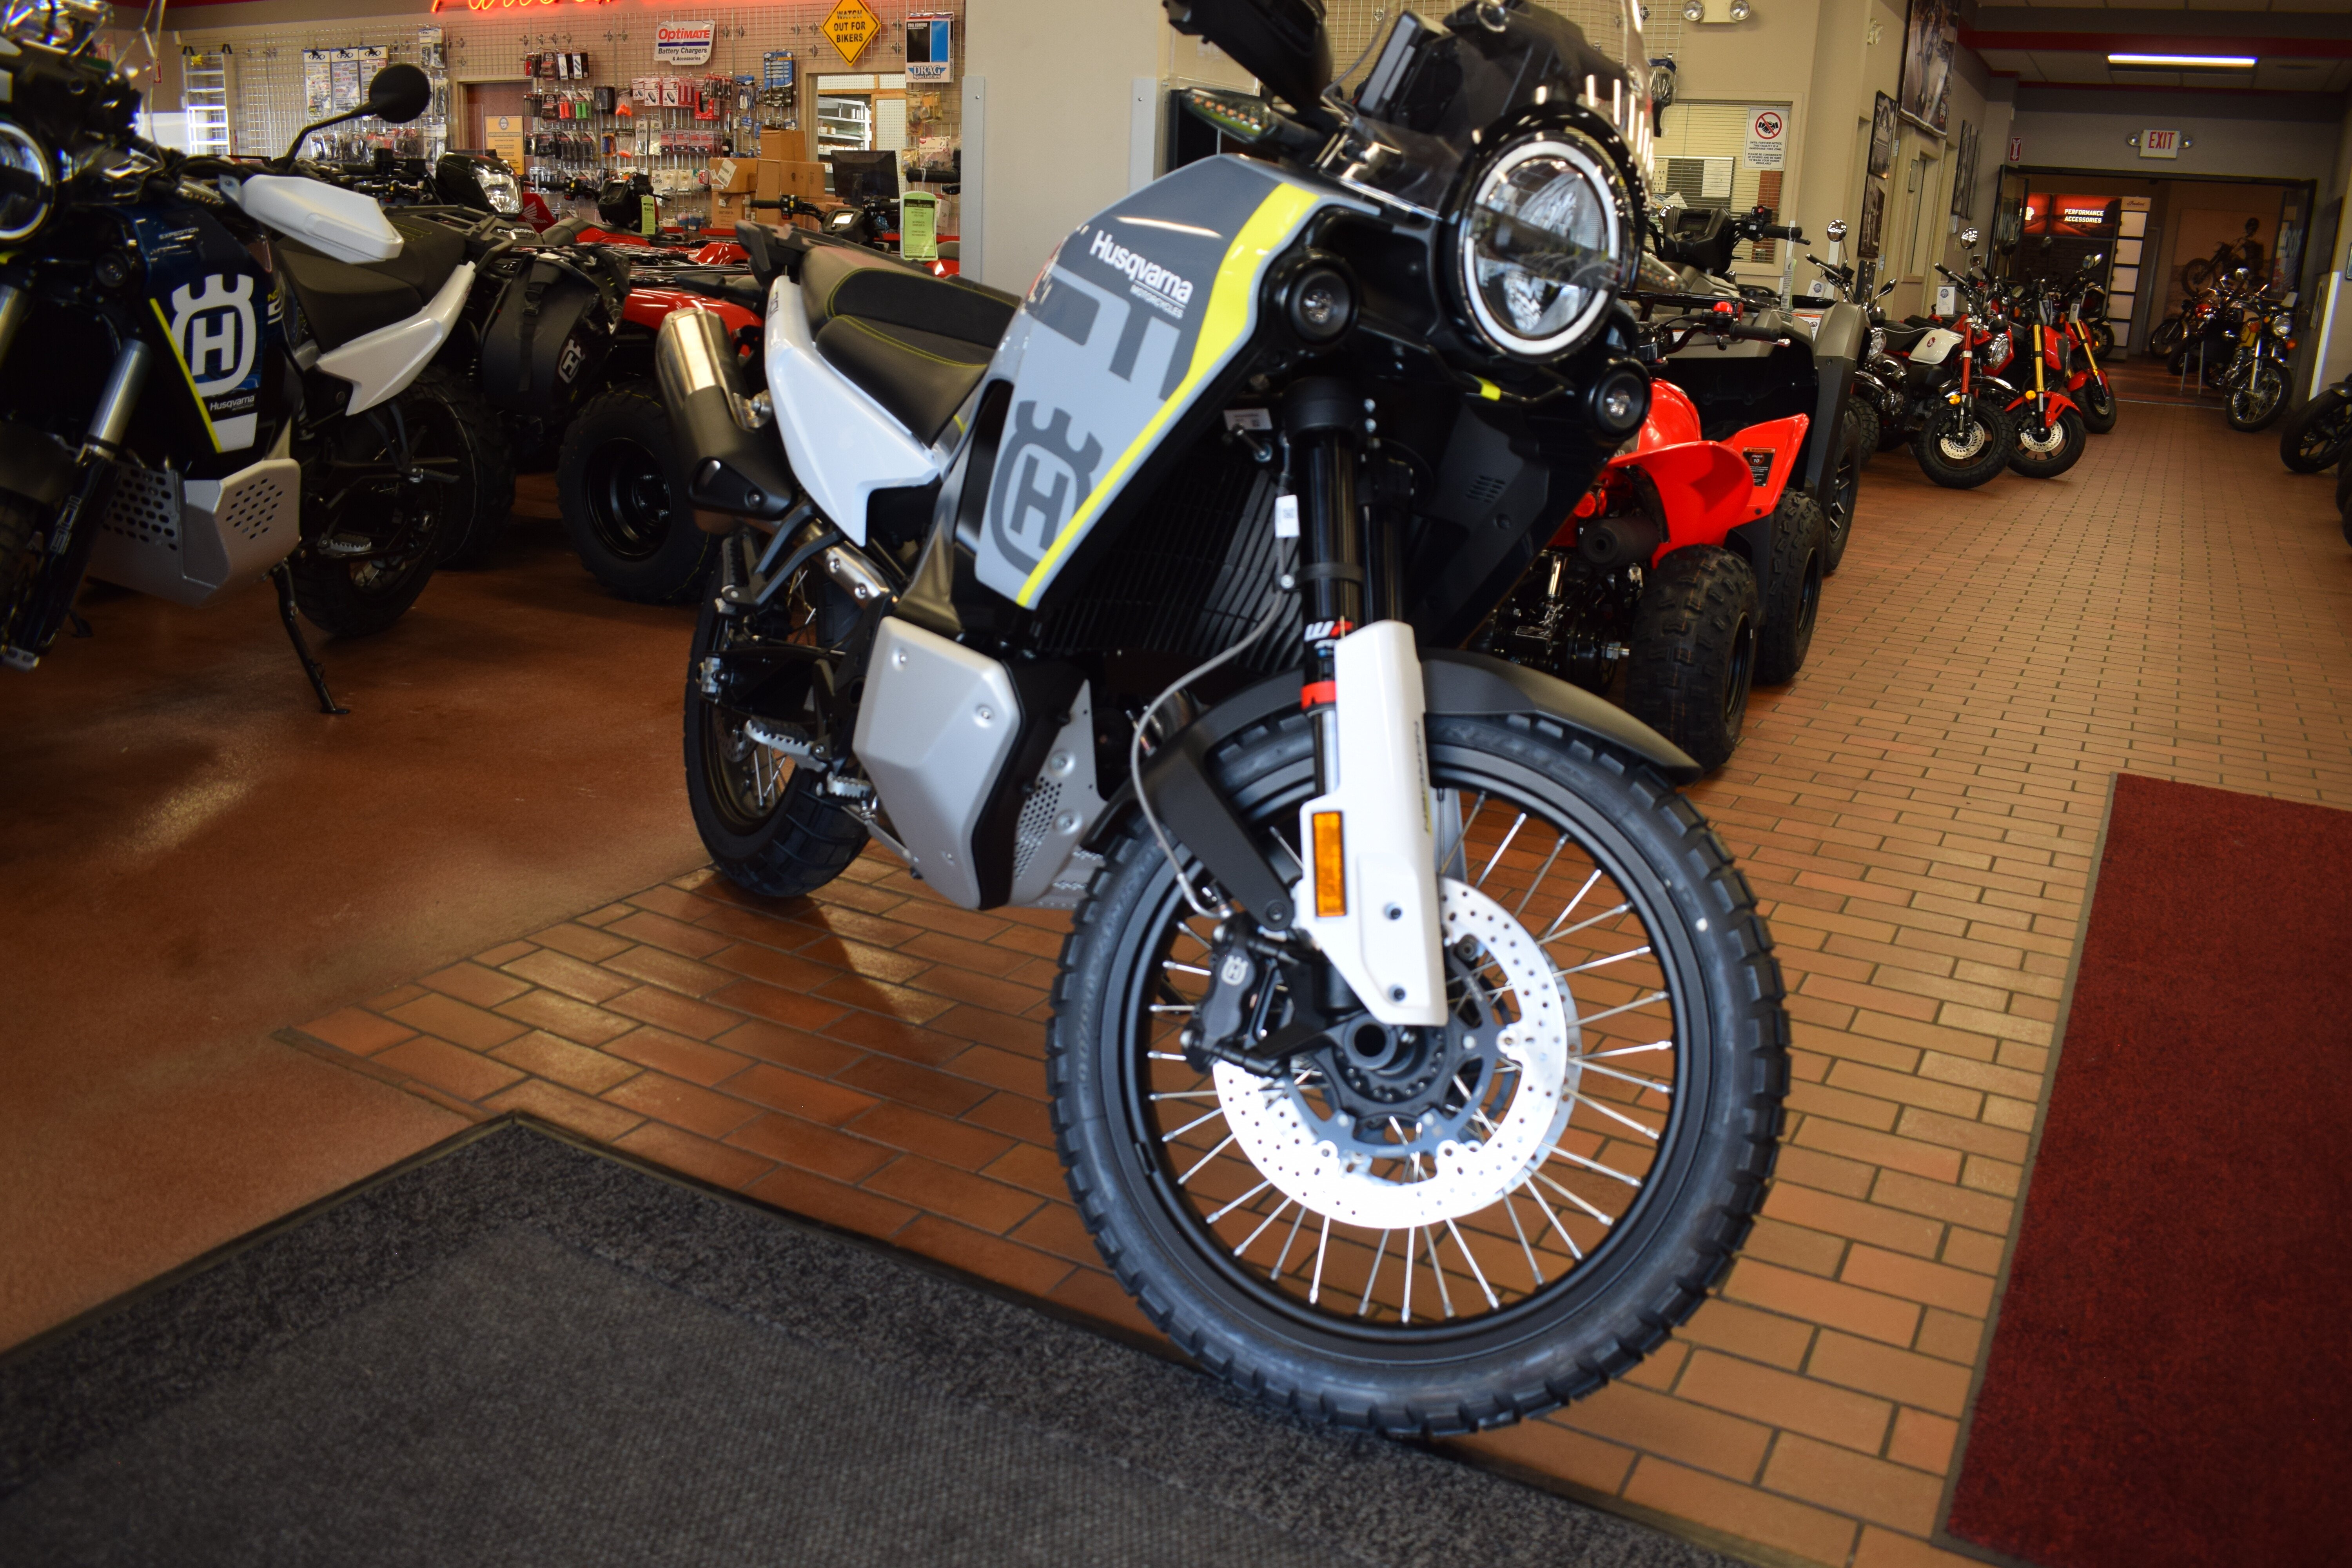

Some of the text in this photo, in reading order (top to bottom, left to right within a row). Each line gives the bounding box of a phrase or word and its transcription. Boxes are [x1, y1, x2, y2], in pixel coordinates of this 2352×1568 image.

[837, 10, 862, 19] WATCH
[834, 22, 866, 31] OUT FOR
[659, 28, 710, 42] OptiMATE
[837, 33, 863, 43] BIKERS
[913, 65, 941, 75] DRAG
[2148, 132, 2175, 149] EXIT
[1089, 229, 1194, 305] Husqvarna
[1129, 284, 1184, 320] MOTORCYCLES
[210, 395, 255, 411] Husqvarna
